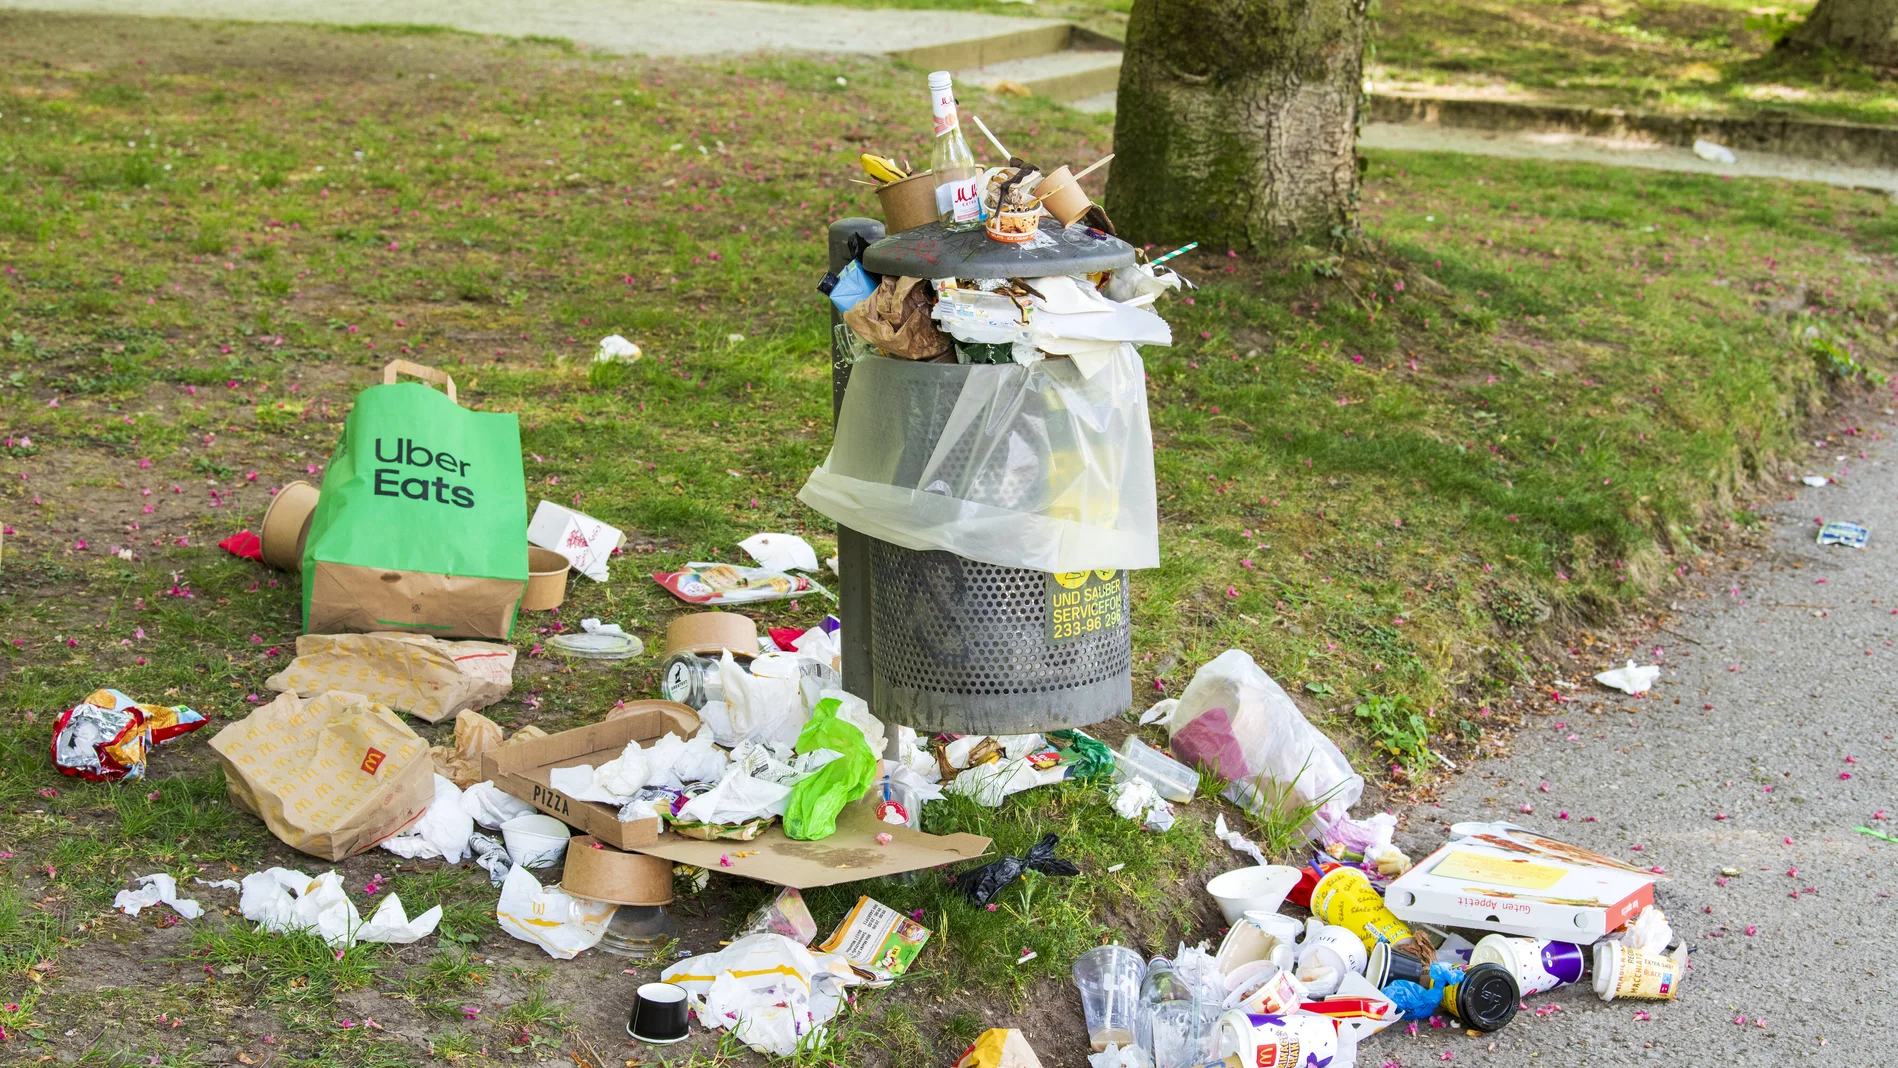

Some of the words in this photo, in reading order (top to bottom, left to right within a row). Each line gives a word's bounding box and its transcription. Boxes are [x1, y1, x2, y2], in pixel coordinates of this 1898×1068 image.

[374, 438, 470, 478] Uber
[374, 469, 475, 508] Eats
[1053, 591, 1080, 607] UND
[1084, 579, 1120, 602] SAUBER
[1054, 616, 1101, 638] 233-96
[1105, 609, 1121, 628] 296
[532, 784, 570, 816] PIZZA
[1458, 896, 1498, 911] Appetit
[1502, 902, 1530, 914] Guten
[1630, 952, 1643, 993] MACCHIATO
